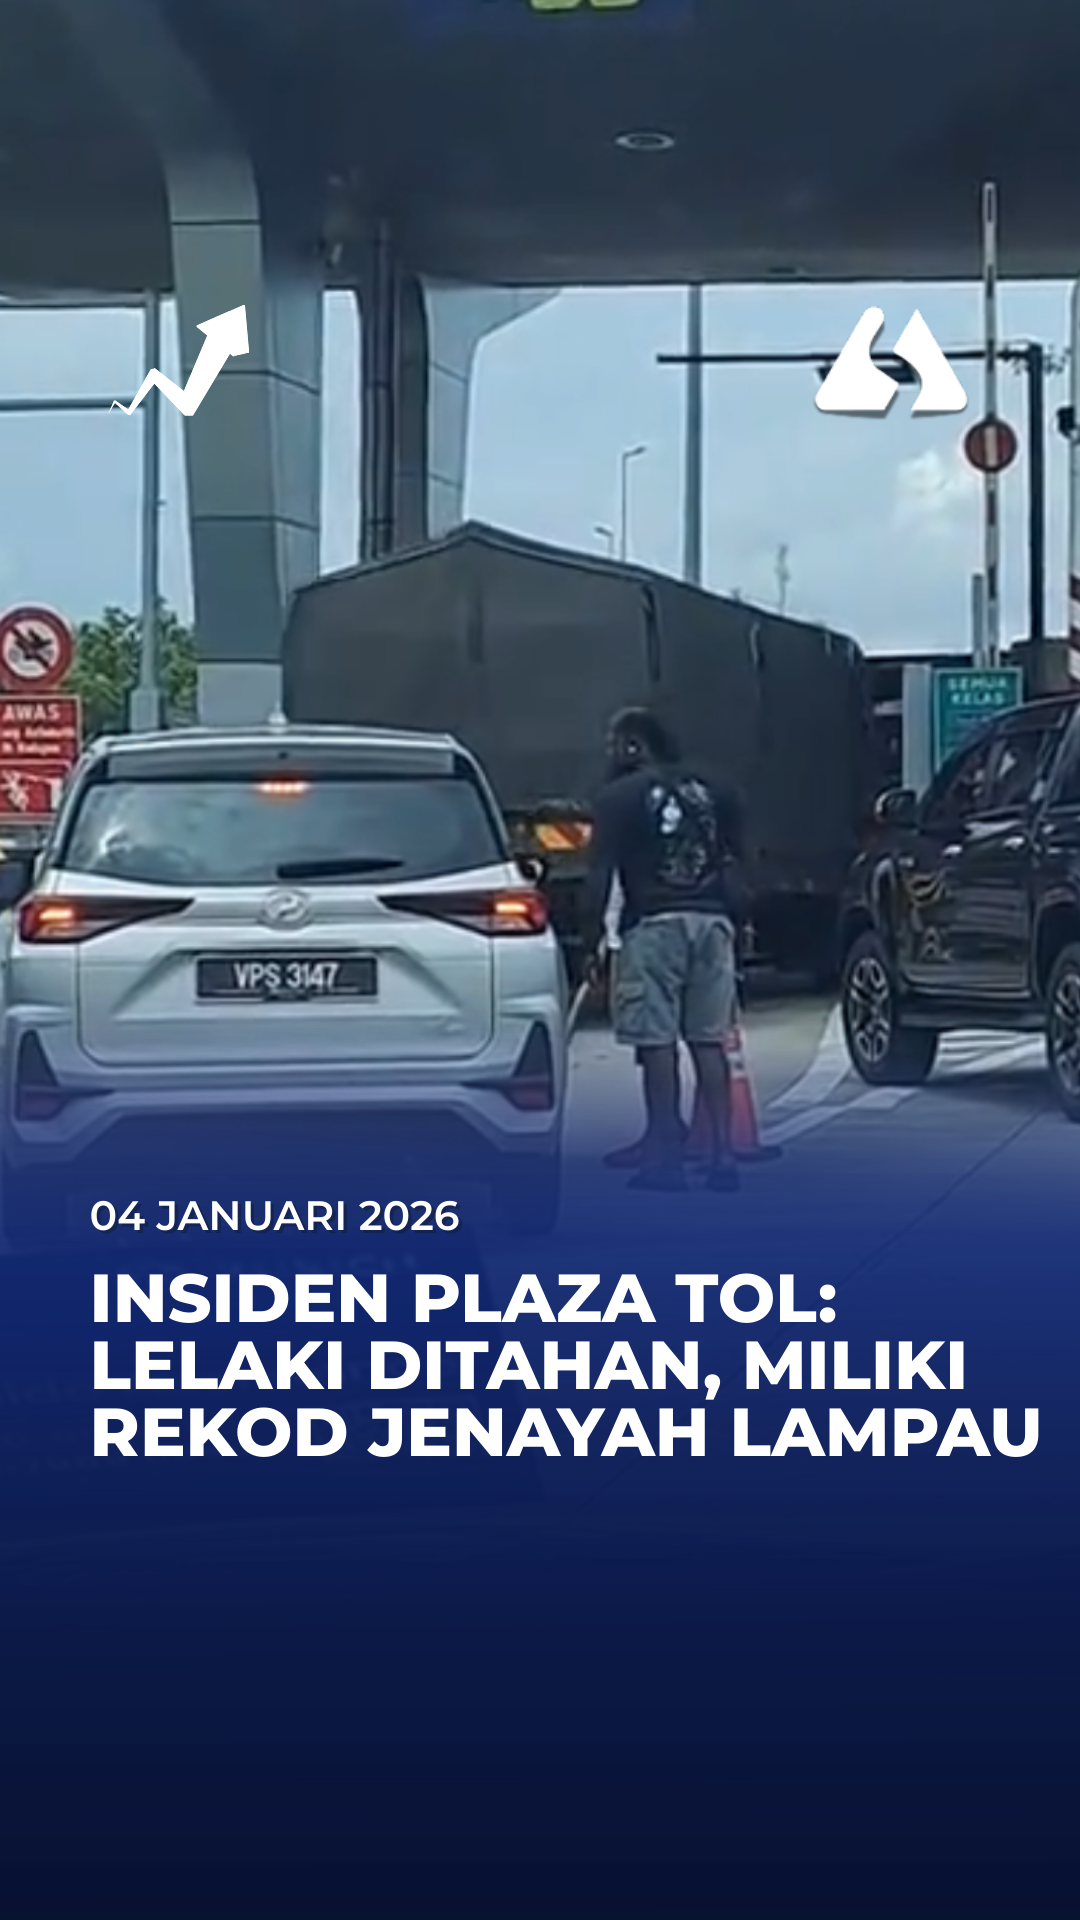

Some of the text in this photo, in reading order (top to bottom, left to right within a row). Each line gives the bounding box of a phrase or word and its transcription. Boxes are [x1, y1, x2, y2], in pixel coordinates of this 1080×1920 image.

[2, 703, 60, 721] AWAS
[233, 962, 340, 990] VPS 3147
